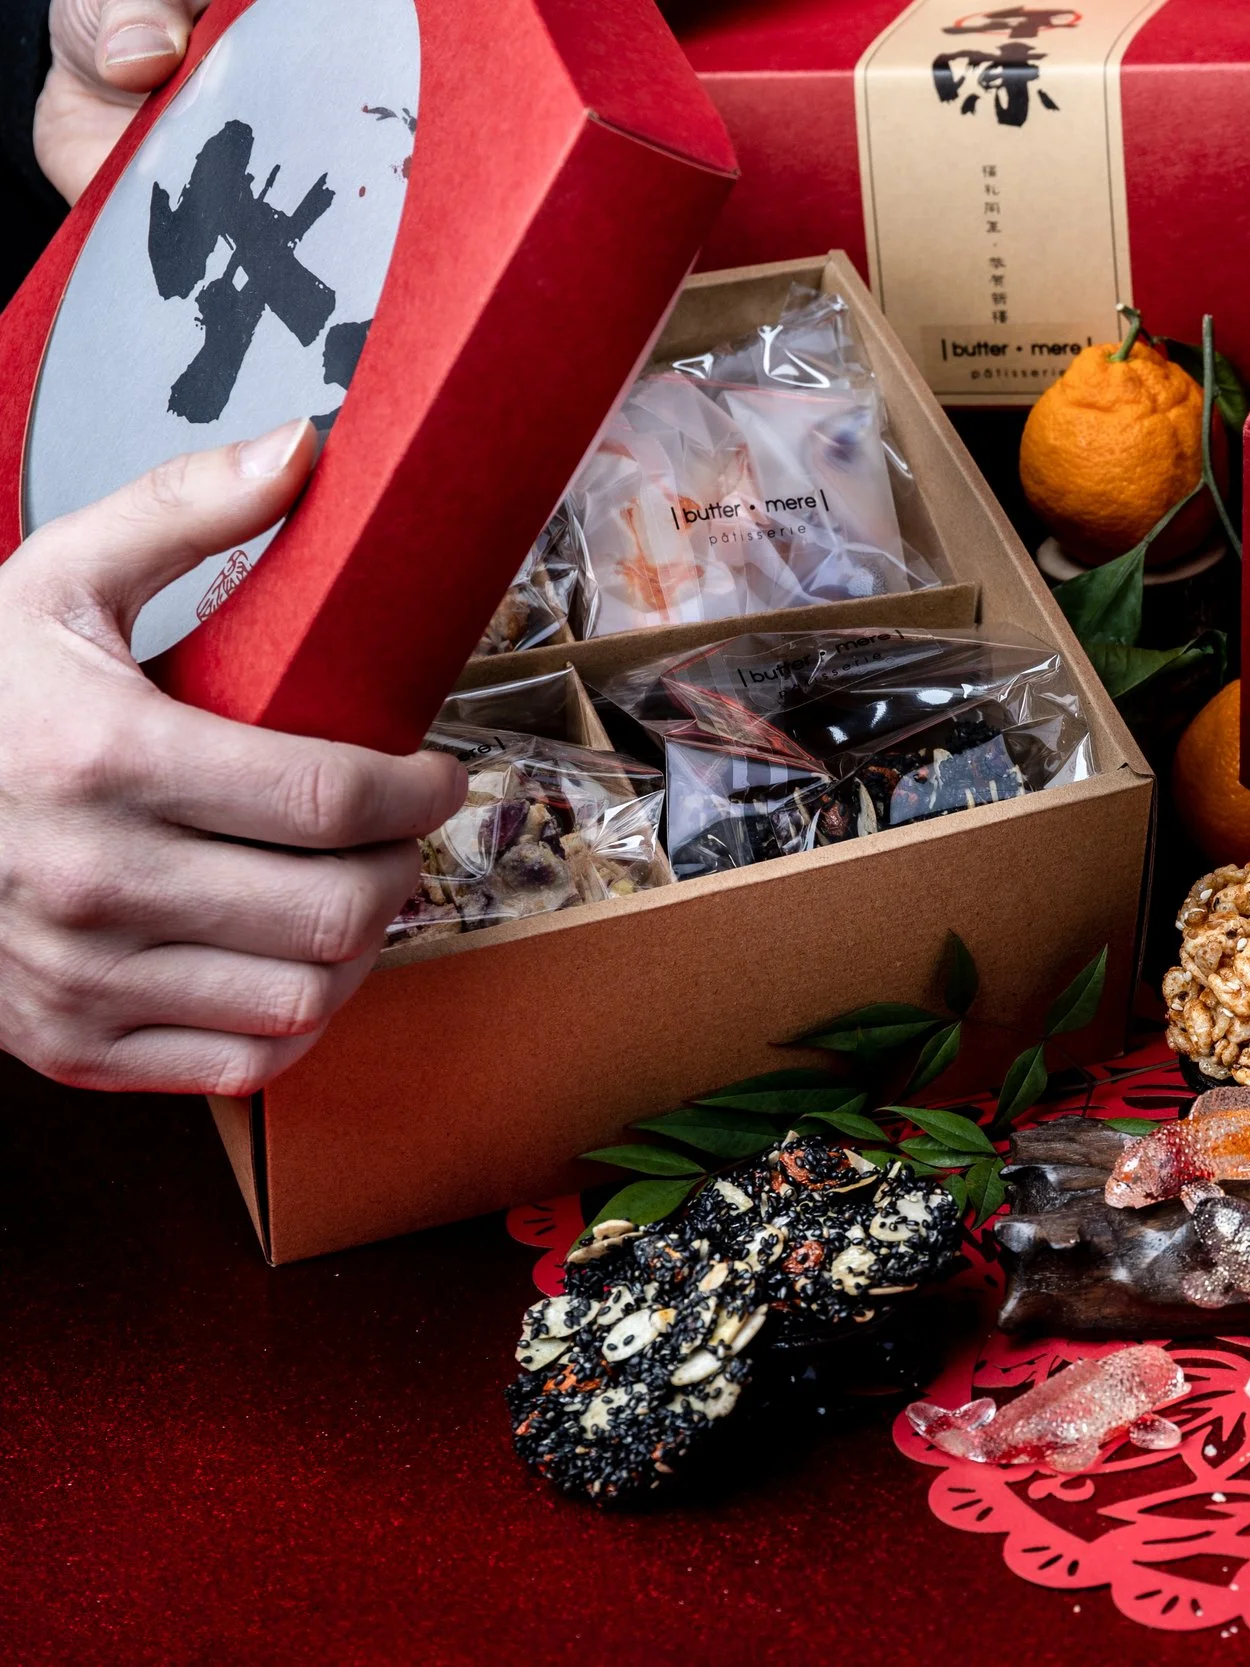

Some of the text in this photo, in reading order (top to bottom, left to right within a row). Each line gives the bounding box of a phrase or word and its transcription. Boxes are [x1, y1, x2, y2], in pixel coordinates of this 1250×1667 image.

[148, 119, 374, 432] 年
[952, 342, 1082, 357] butter mere
[683, 495, 817, 523] butter mere
[835, 631, 892, 653] mere
